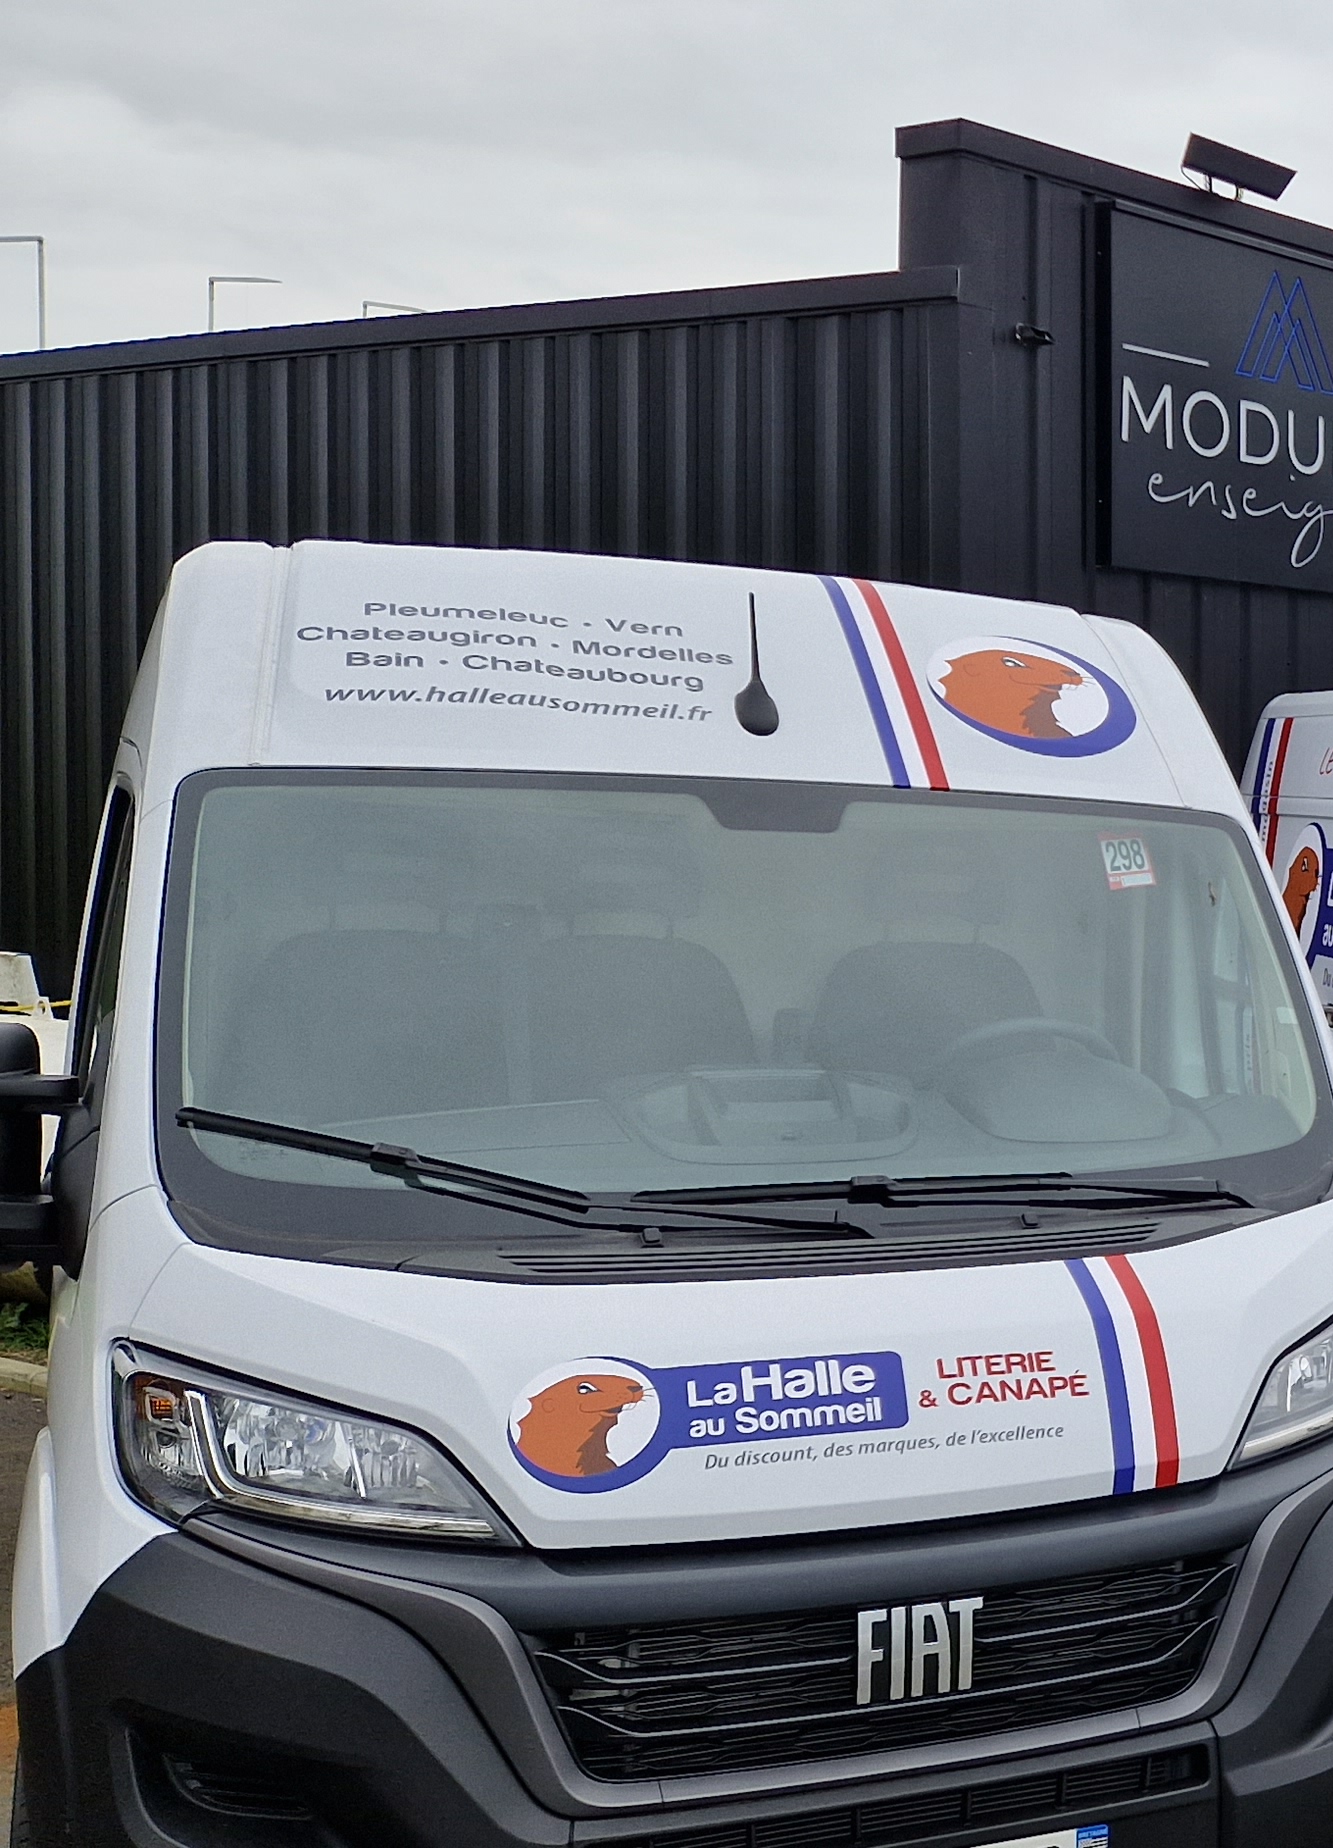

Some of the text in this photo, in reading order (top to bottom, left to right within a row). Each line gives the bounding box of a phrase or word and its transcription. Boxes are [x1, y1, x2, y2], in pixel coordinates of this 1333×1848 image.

[364, 602, 683, 637] Pleumeleuc Vern
[297, 625, 734, 666] Chateaugiron Mordelles
[345, 652, 705, 692] Bain Chateaubourg
[324, 686, 713, 722] www.halleausommeil.fr
[1105, 839, 1146, 872] 298
[687, 1359, 876, 1408] La Halle
[936, 1351, 1056, 1379] LITERIE
[918, 1369, 1090, 1408] & CANAPÉ
[689, 1396, 882, 1438] au Sommeil
[705, 1425, 1064, 1470] Du discount, des marques, de l'excellence
[857, 1596, 984, 1705] FIAT
